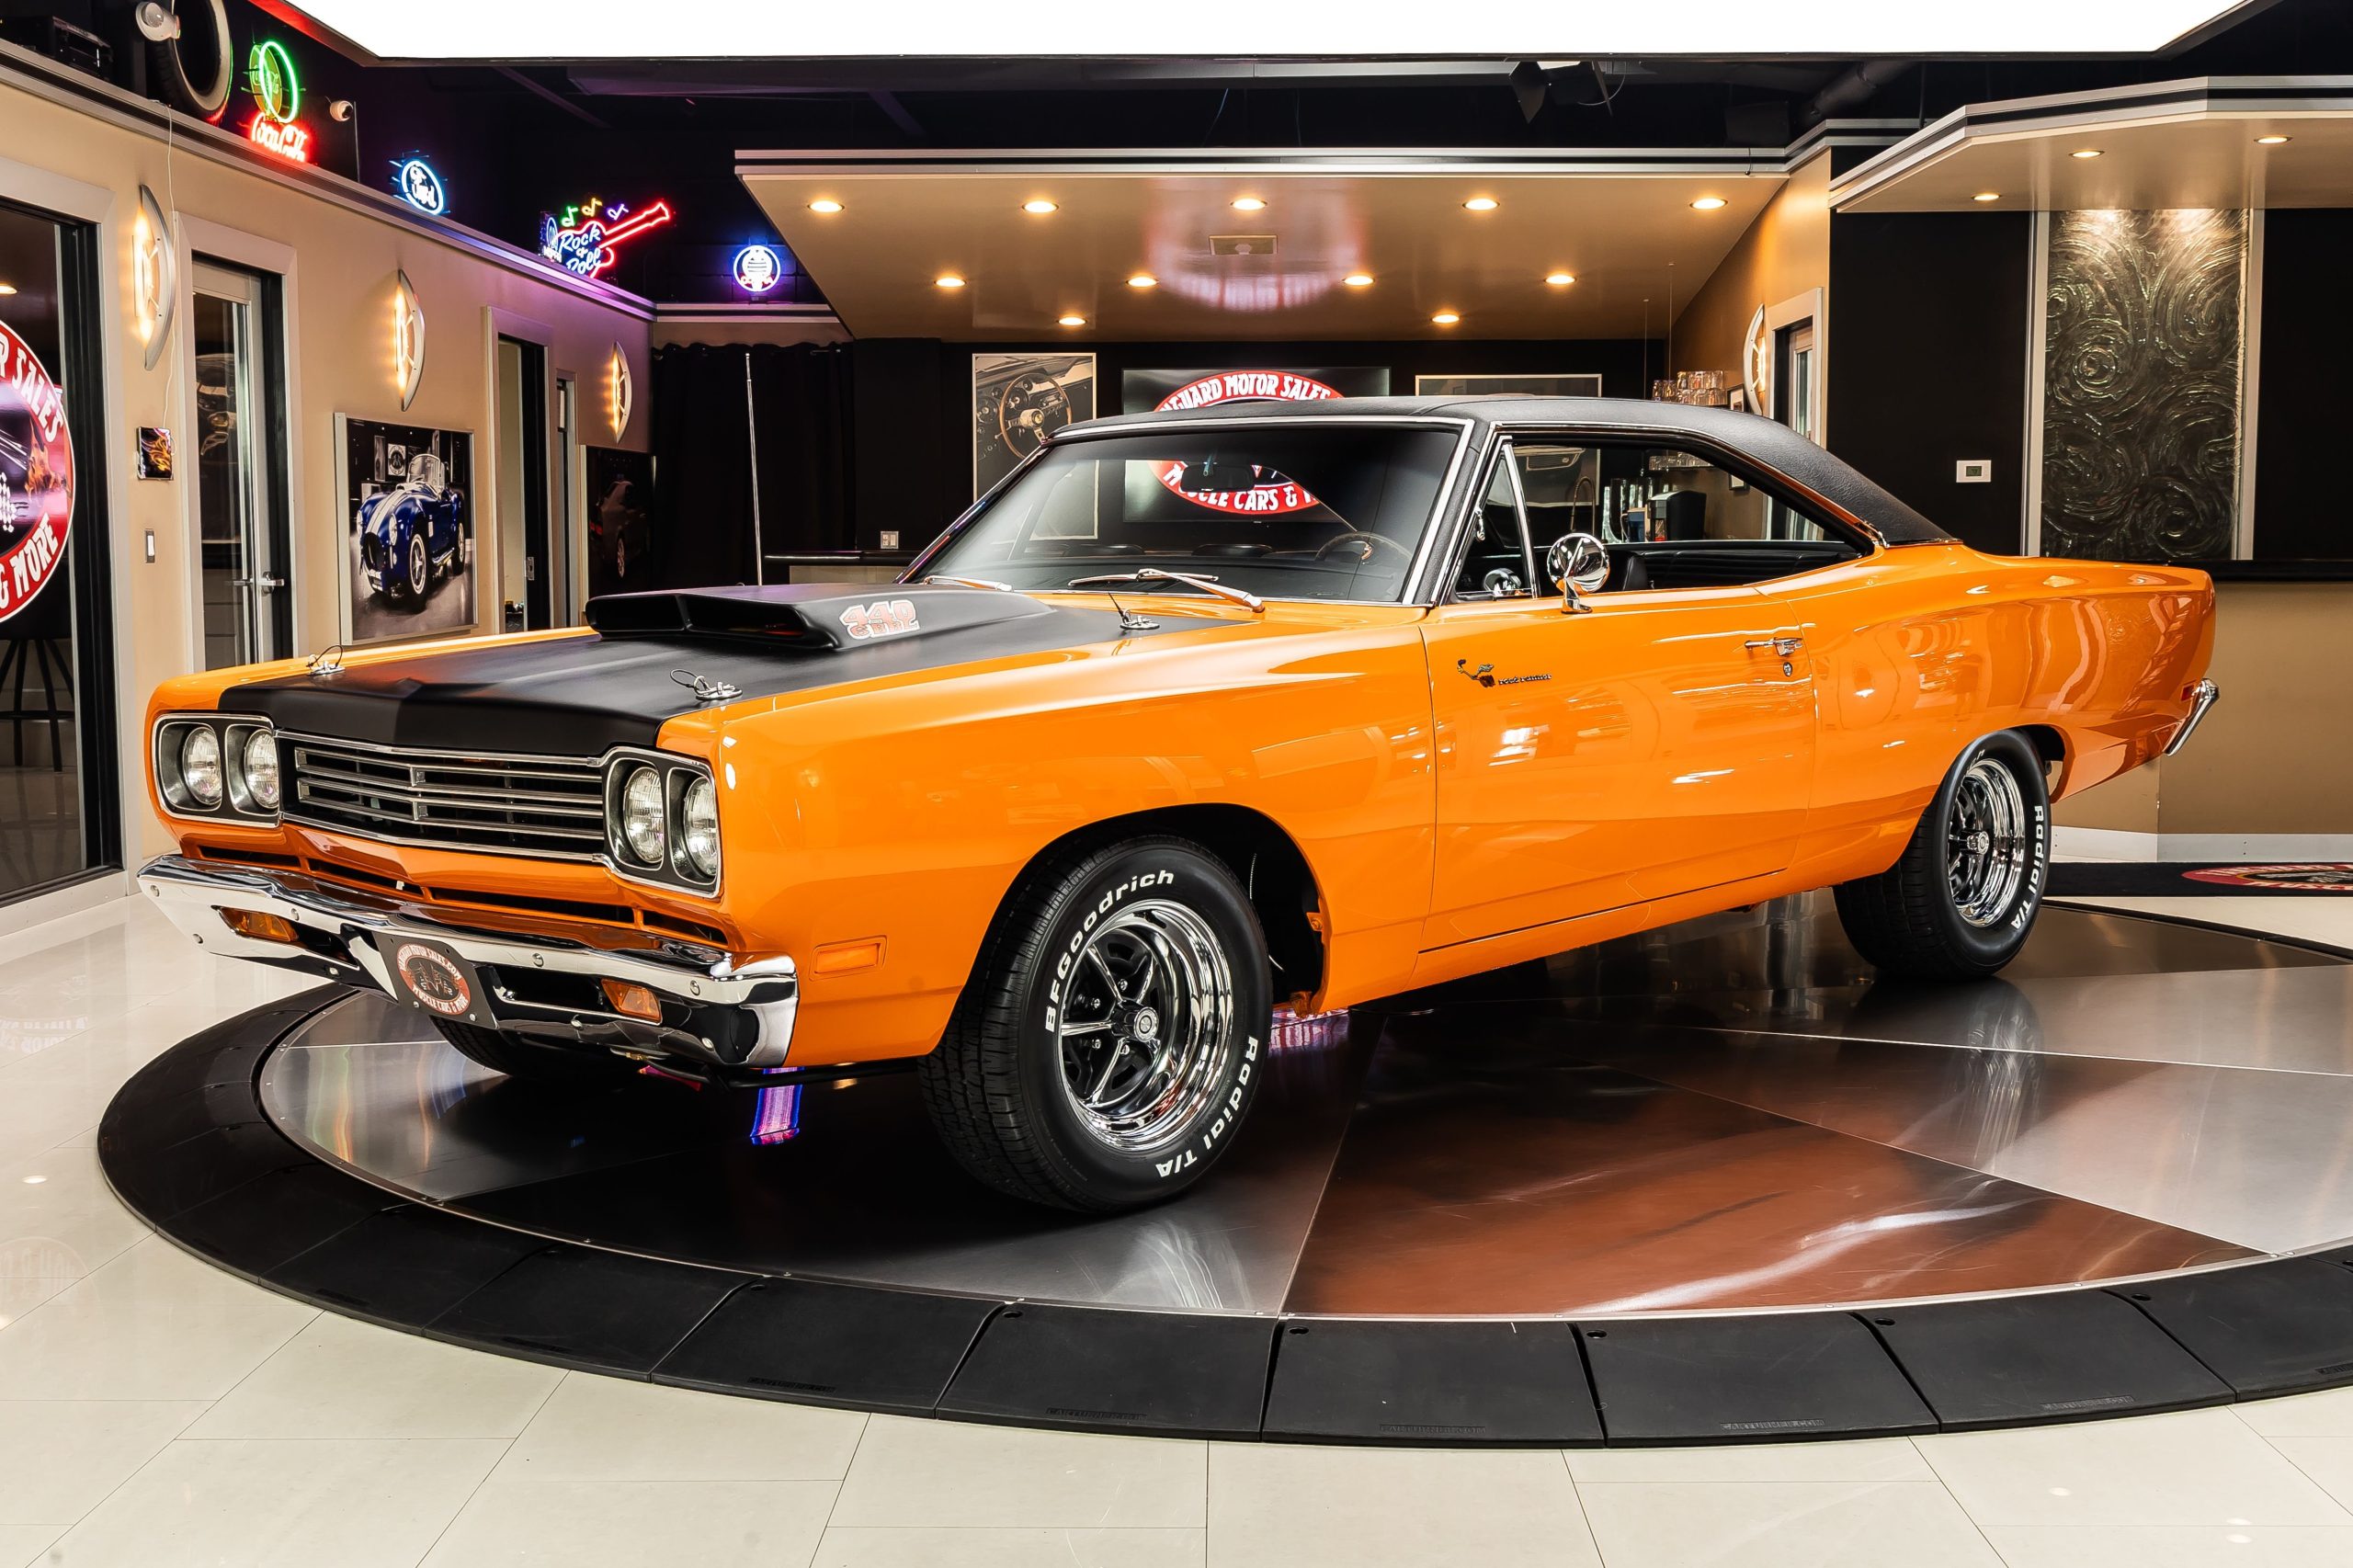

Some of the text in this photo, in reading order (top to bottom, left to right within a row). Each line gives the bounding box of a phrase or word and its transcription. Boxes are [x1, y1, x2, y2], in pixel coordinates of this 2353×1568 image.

[559, 223, 601, 254] Rock
[12, 347, 63, 442] SALES
[1223, 373, 1279, 397] MOTOR
[1233, 489, 1279, 511] CARS
[1283, 485, 1298, 507] &
[9, 513, 58, 599] MORE
[2011, 805, 2044, 930] Radial T/A
[1045, 869, 1175, 1033] BFGoodrich
[1155, 1036, 1259, 1178] Radial T/A
